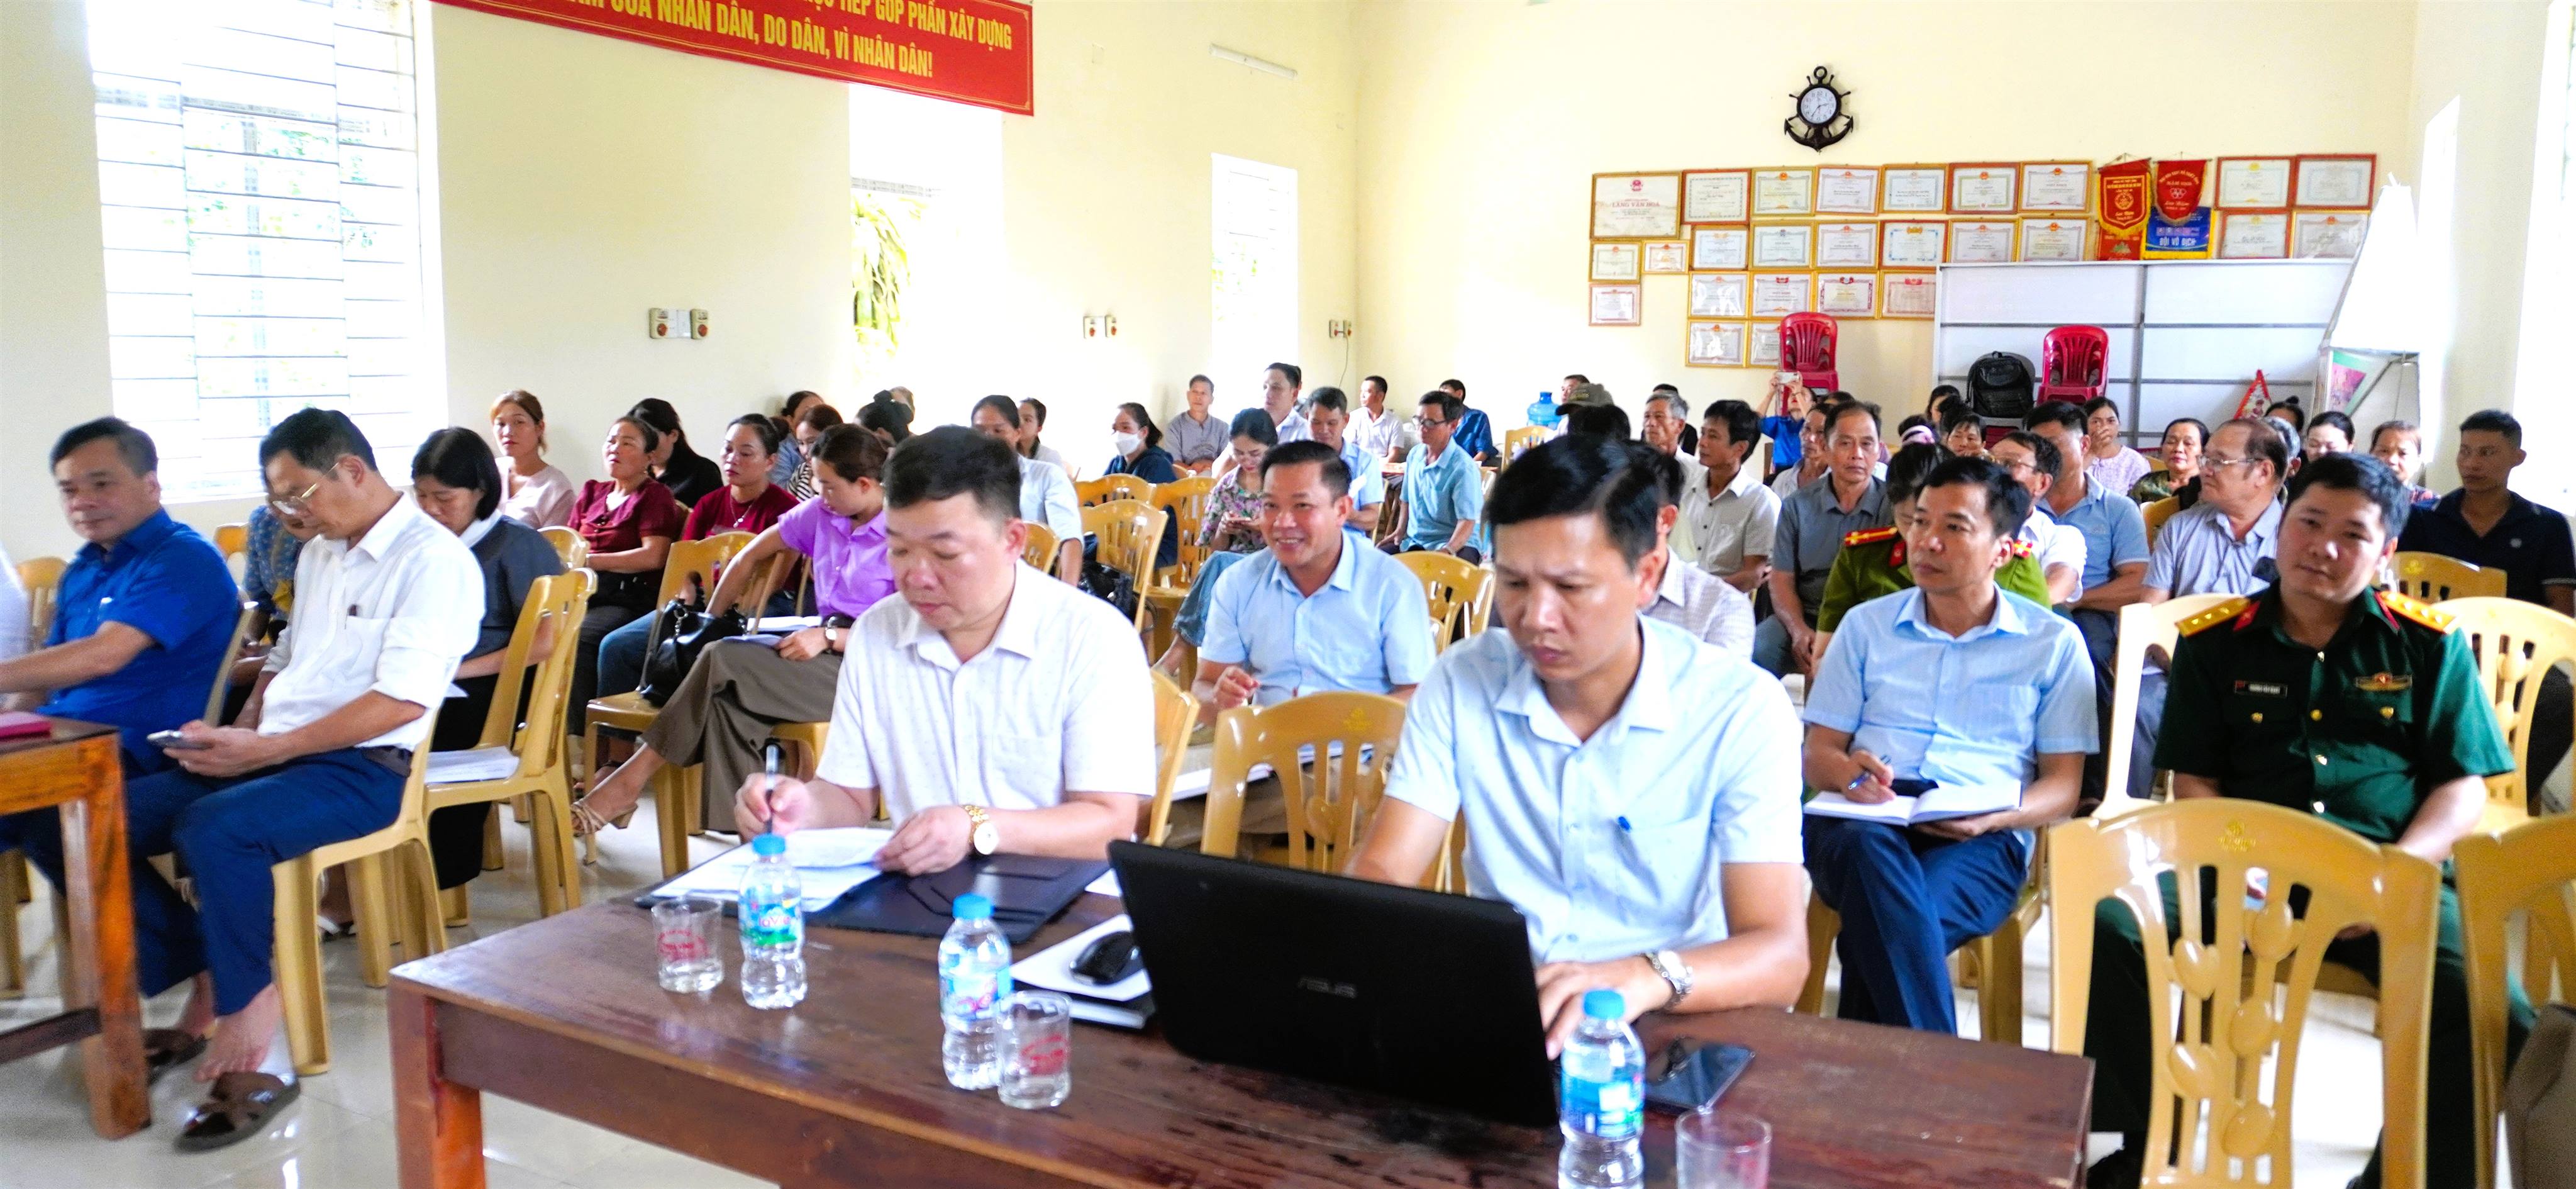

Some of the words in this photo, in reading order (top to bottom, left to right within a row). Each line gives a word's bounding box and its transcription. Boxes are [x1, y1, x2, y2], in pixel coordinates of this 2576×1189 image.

[716, 1, 759, 44] DÂN,
[763, 14, 786, 47] DO
[791, 17, 830, 59] DÂN,
[833, 26, 849, 60] VÌ
[853, 34, 896, 69] NHÂN
[898, 42, 933, 77] DÂN!
[949, 8, 975, 42] XÂY
[977, 18, 1012, 52] DỰNG
